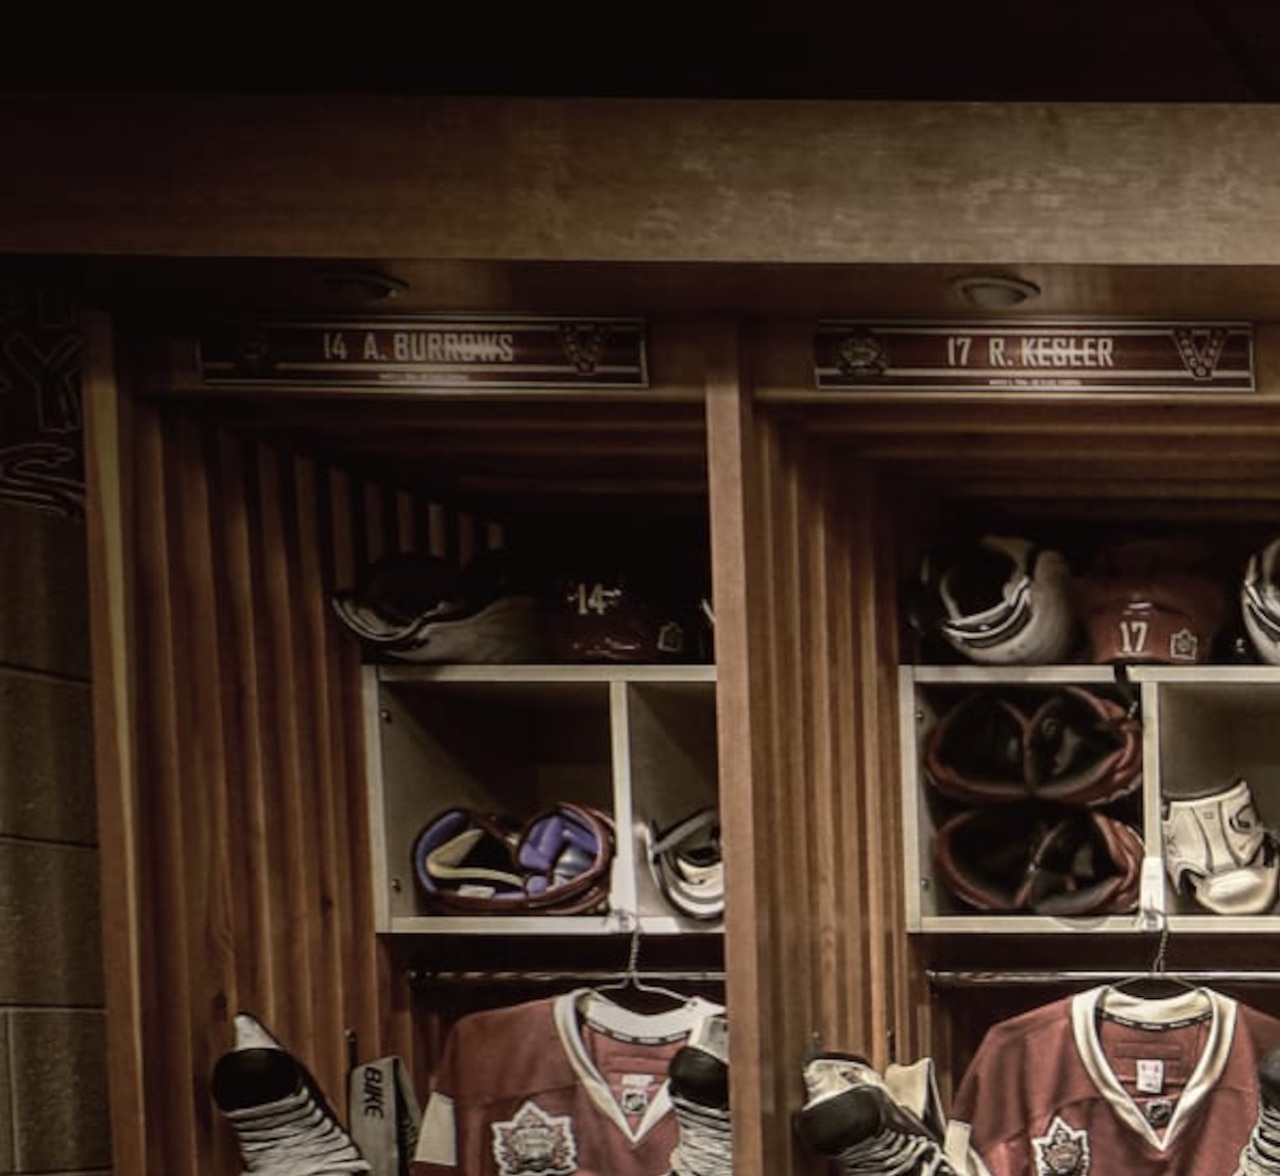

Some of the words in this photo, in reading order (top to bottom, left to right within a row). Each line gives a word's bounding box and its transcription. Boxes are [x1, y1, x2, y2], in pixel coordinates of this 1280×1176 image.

[323, 332, 347, 360] 14
[363, 332, 388, 361] A.
[392, 332, 514, 362] BURROWS
[946, 336, 973, 367] 17
[988, 336, 1015, 367] R.
[1020, 336, 1114, 367] KESLER
[1119, 621, 1148, 653] 17
[364, 1065, 385, 1119] BIKE
